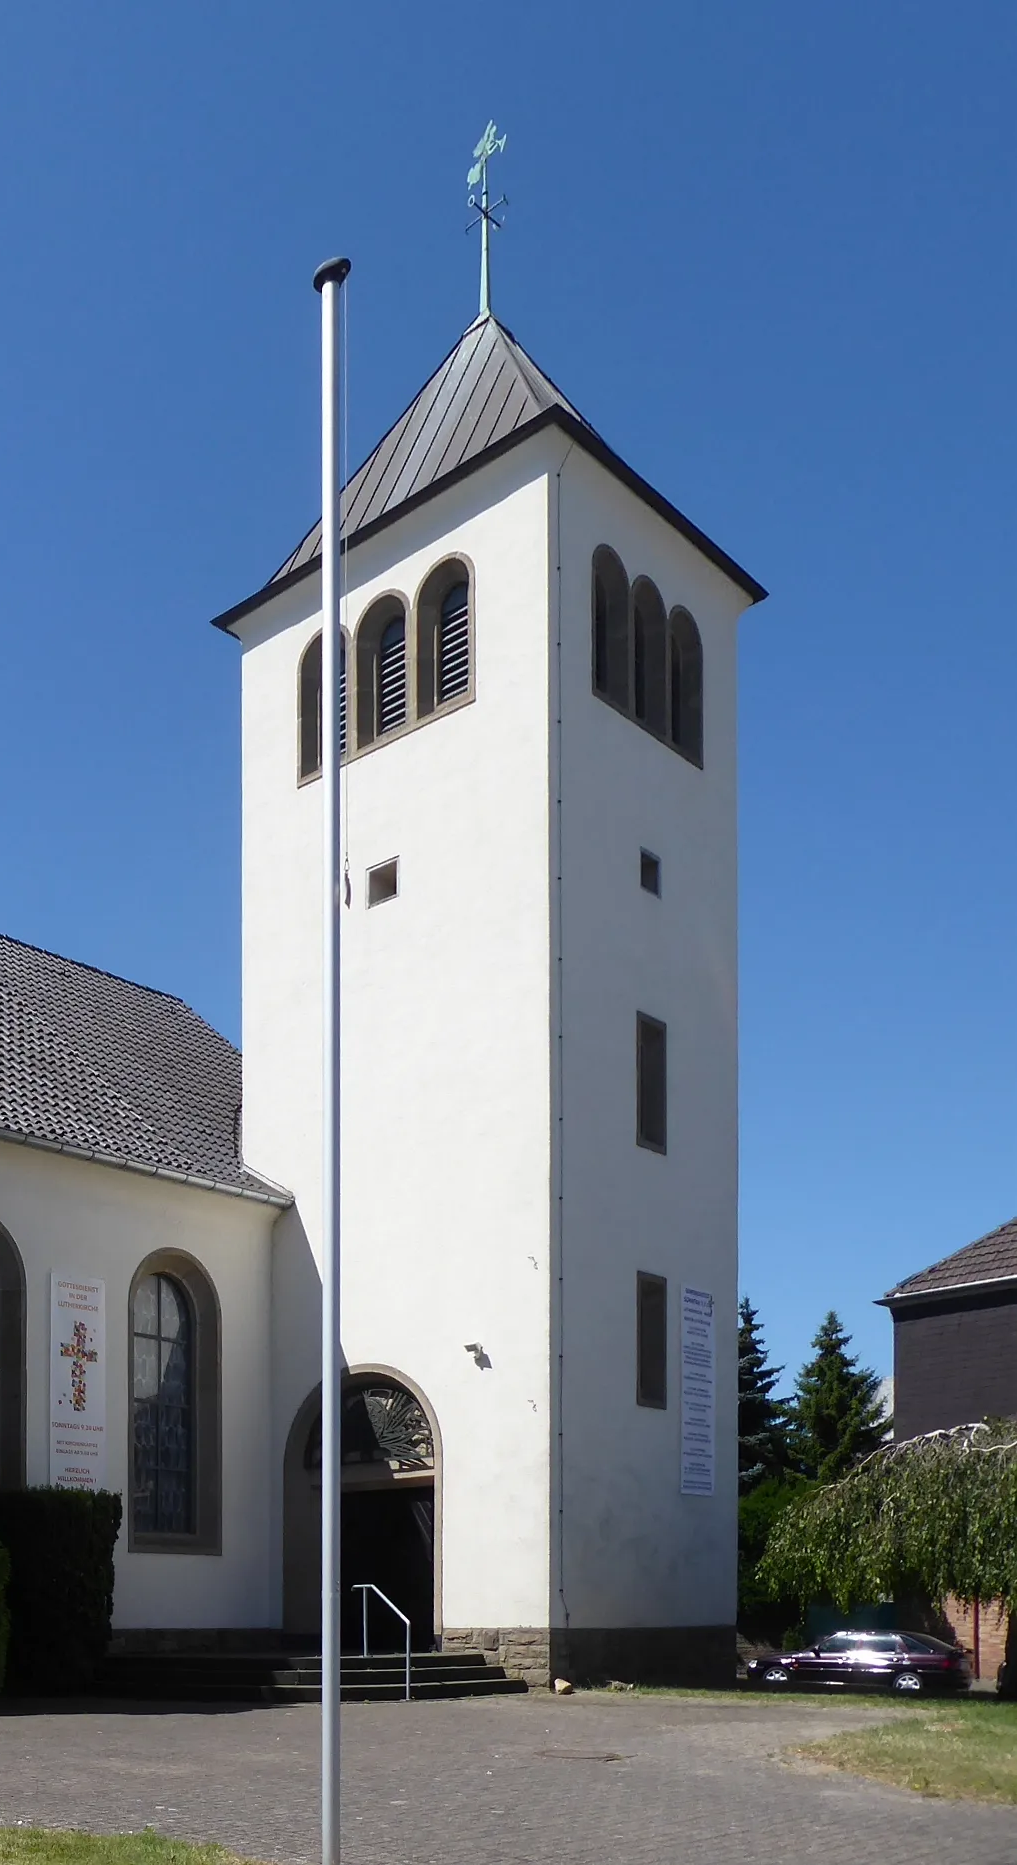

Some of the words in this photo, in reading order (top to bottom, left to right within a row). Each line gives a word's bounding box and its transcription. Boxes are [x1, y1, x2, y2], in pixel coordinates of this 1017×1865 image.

[58, 1281, 99, 1293] GOTTESDIENST
[58, 1300, 99, 1311] LUTHERKIRCHE
[51, 1421, 80, 1430] SONNTAGS
[57, 1475, 94, 1484] WILLKOMMEN
